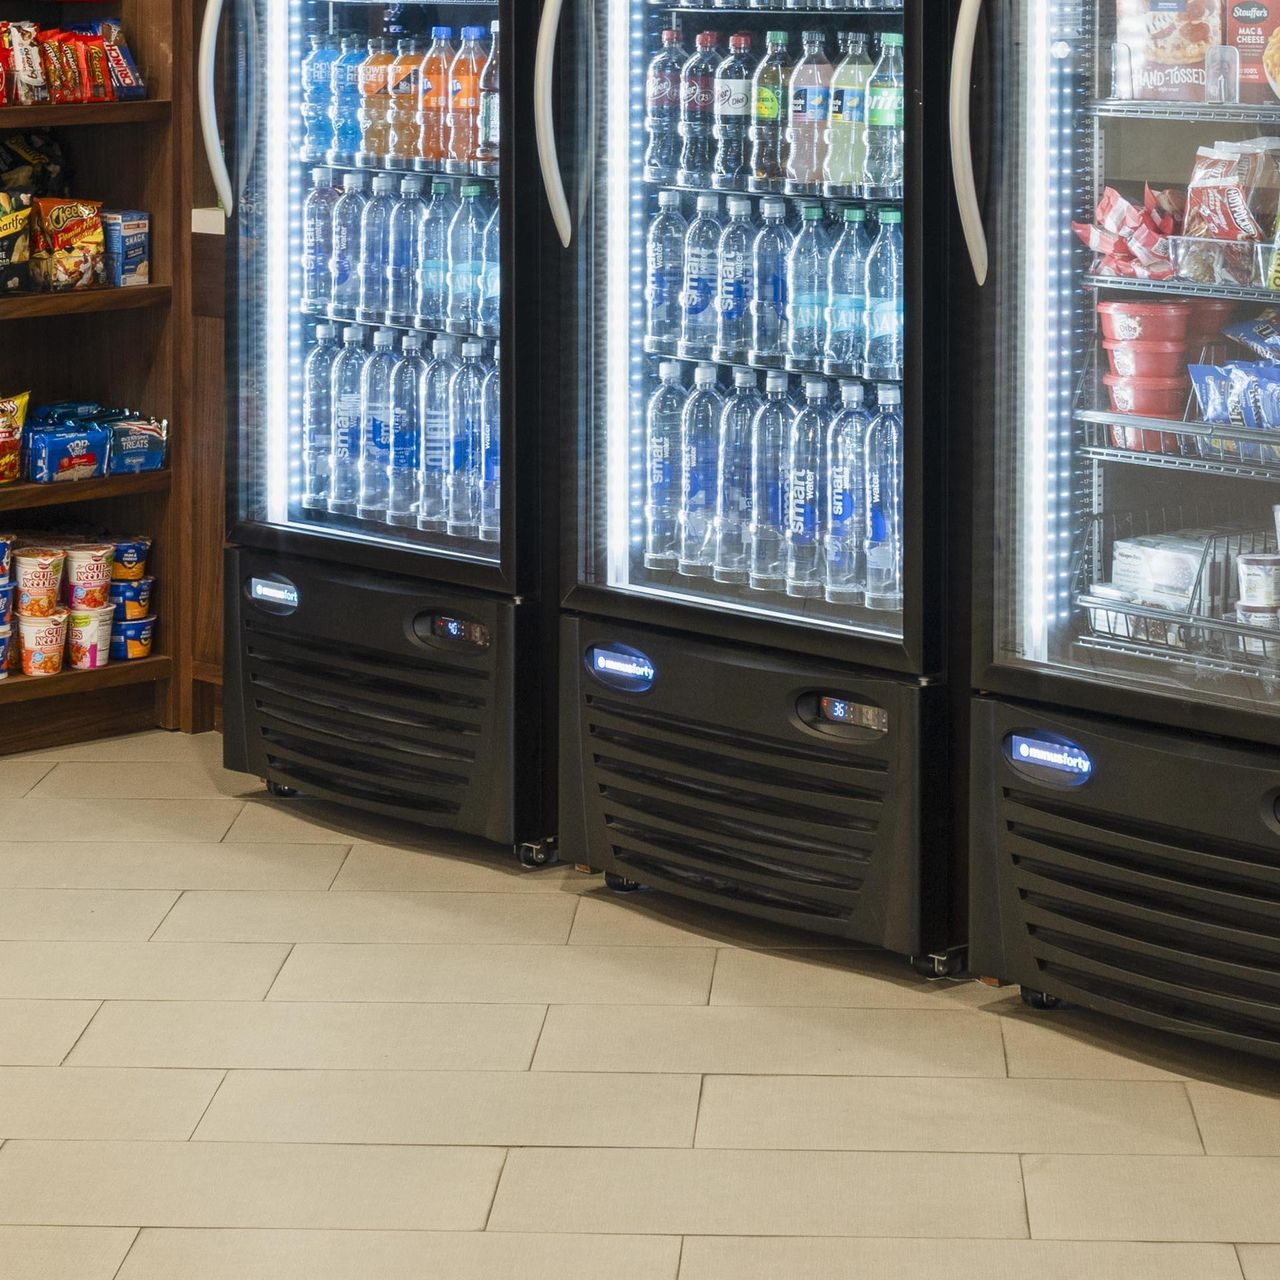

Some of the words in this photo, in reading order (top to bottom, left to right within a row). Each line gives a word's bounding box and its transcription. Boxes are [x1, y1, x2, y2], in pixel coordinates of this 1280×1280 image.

[1232, 6, 1268, 20] Stouffer's
[1238, 27, 1256, 35] MAC
[1257, 27, 1263, 35] &
[1236, 35, 1265, 44] CHEESE
[23, 47, 39, 80] bueno
[104, 41, 137, 87] CRUNCH
[731, 96, 746, 106] Diet
[340, 225, 348, 250] water
[720, 251, 737, 312] smart
[122, 440, 149, 449] TREATS
[832, 465, 844, 516] smart
[872, 473, 880, 503] water
[790, 468, 807, 535] smart
[806, 469, 816, 500] water
[31, 571, 54, 580] CUP
[77, 570, 112, 581] NOODLES
[85, 564, 107, 573] CUP
[23, 577, 58, 588] NOODLES
[833, 702, 845, 717] 36
